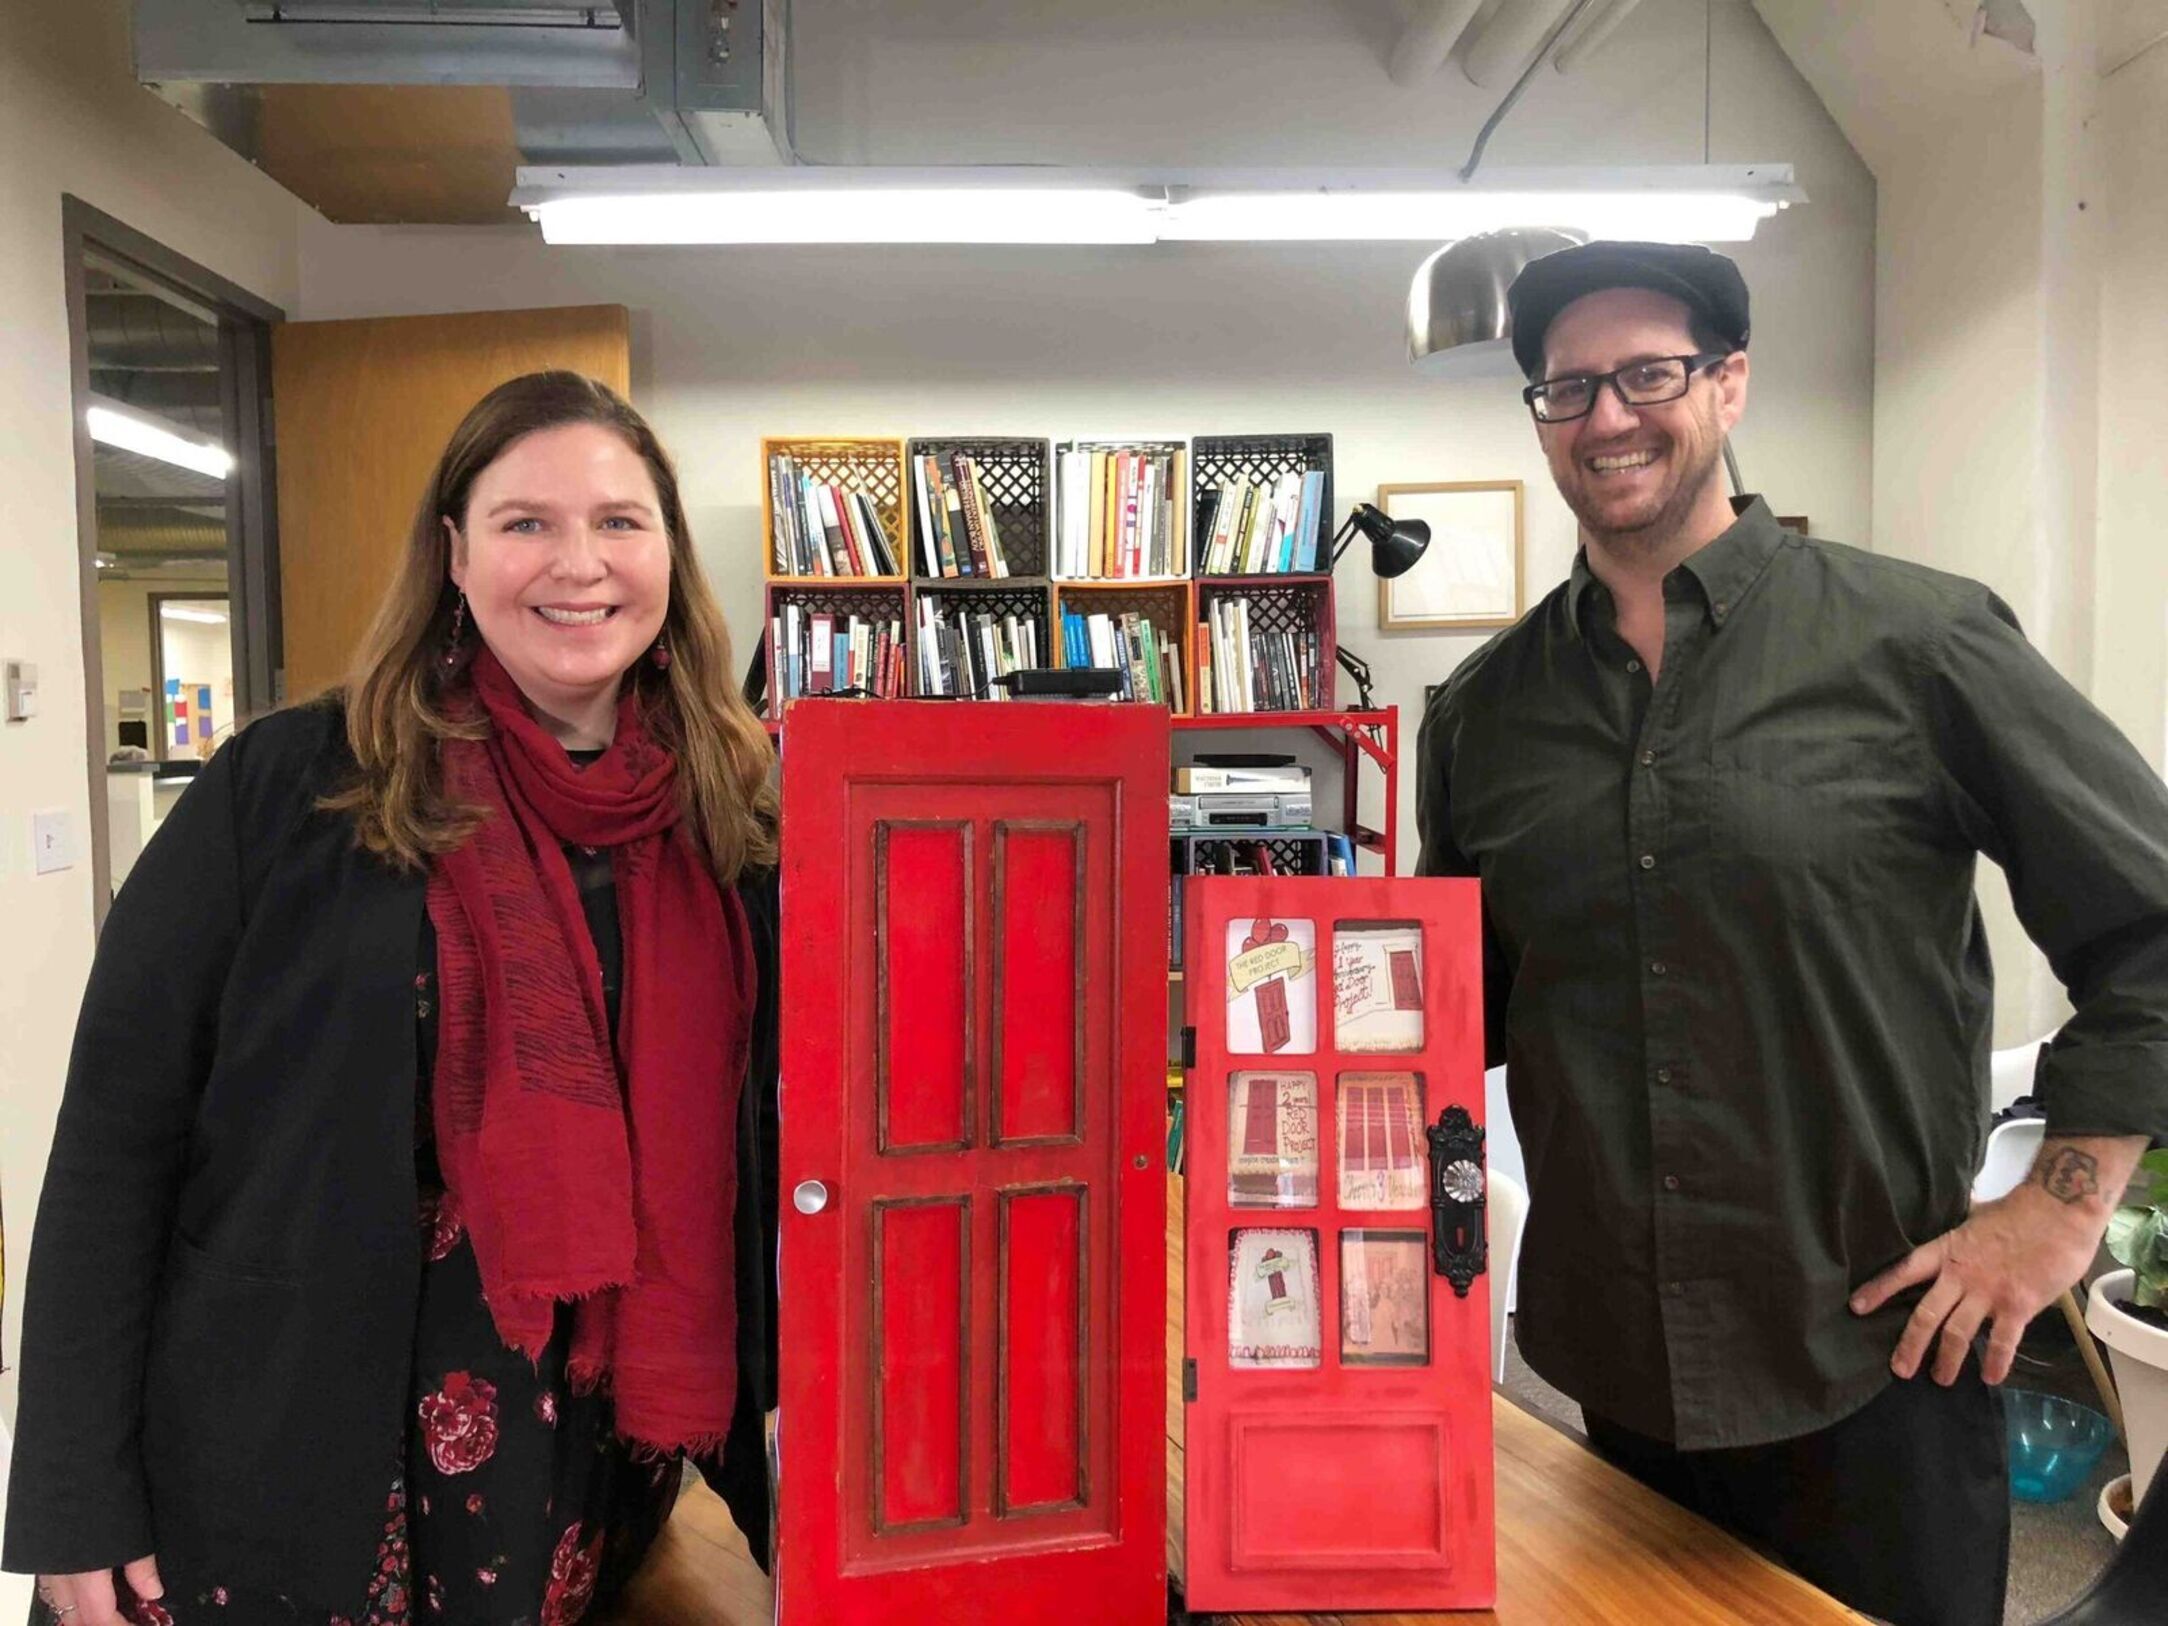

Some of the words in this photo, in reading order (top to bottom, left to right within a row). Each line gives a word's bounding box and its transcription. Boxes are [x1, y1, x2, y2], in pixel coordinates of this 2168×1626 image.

[1264, 944, 1287, 960] DOOR
[1249, 958, 1280, 976] PROJECT
[1281, 1091, 1291, 1106] 2
[1287, 1107, 1307, 1120] RED
[1281, 1120, 1310, 1136] DOOR
[1283, 1137, 1316, 1154] PROJECT
